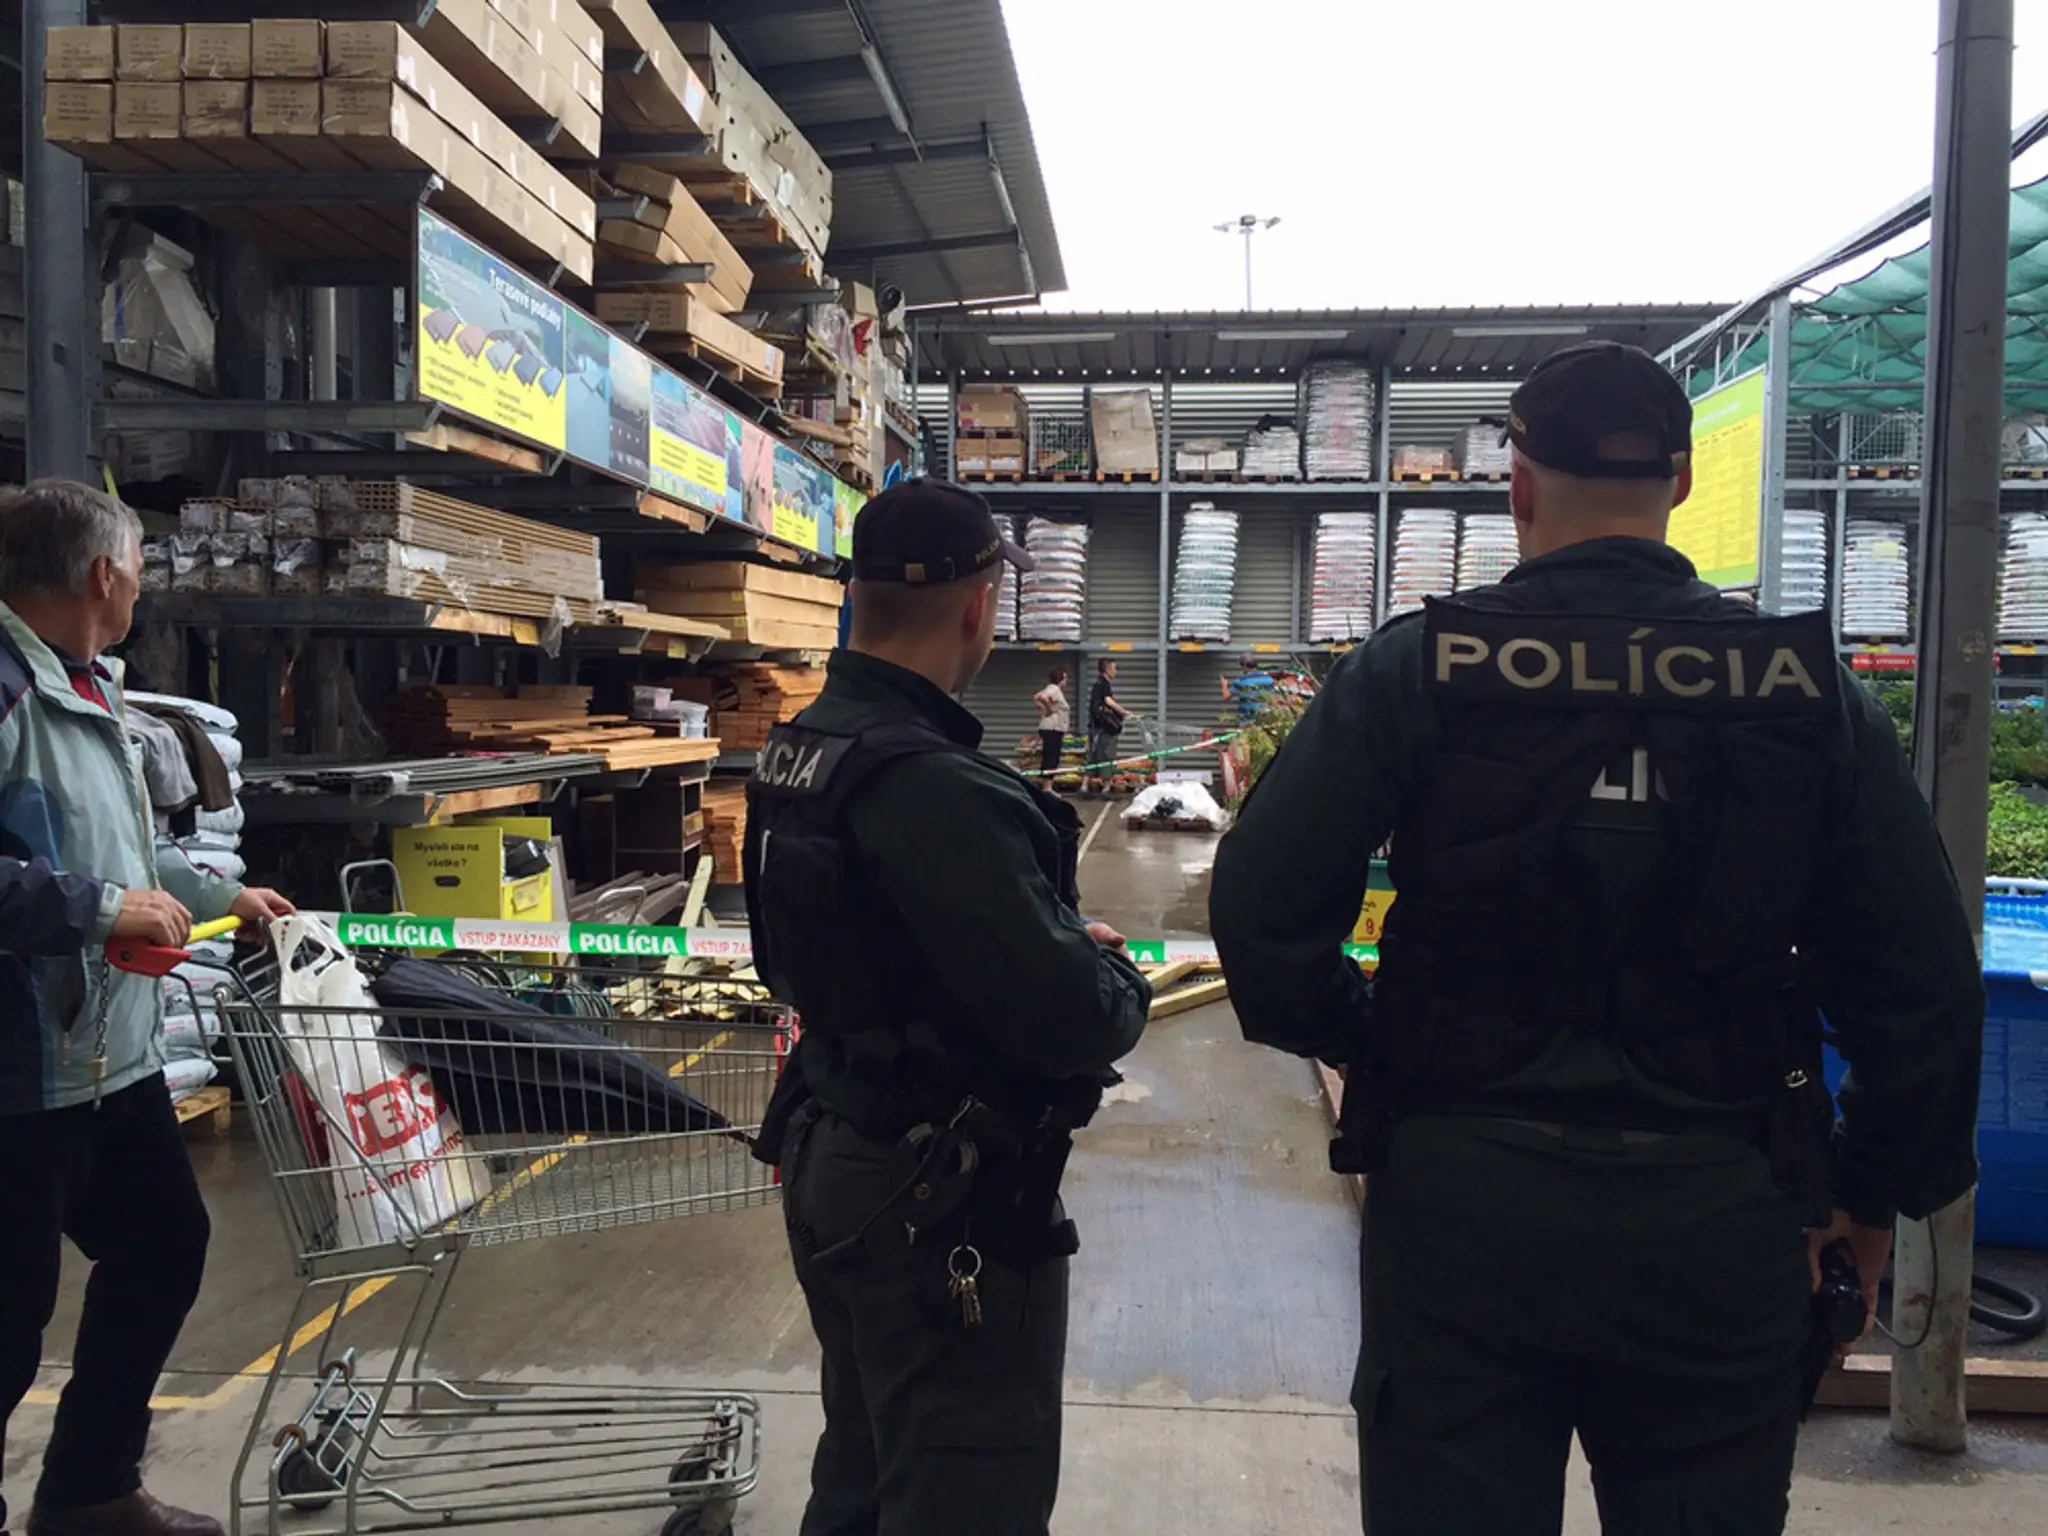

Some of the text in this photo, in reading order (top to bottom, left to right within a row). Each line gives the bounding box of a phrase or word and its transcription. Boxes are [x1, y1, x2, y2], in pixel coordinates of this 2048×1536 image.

[1436, 628, 1822, 698] POLÍCIA
[349, 919, 561, 948] POLÍCIA VSTUP ZAKÁZANÝ
[579, 929, 679, 954] POLÍCIA
[692, 939, 730, 953] VSTUP
